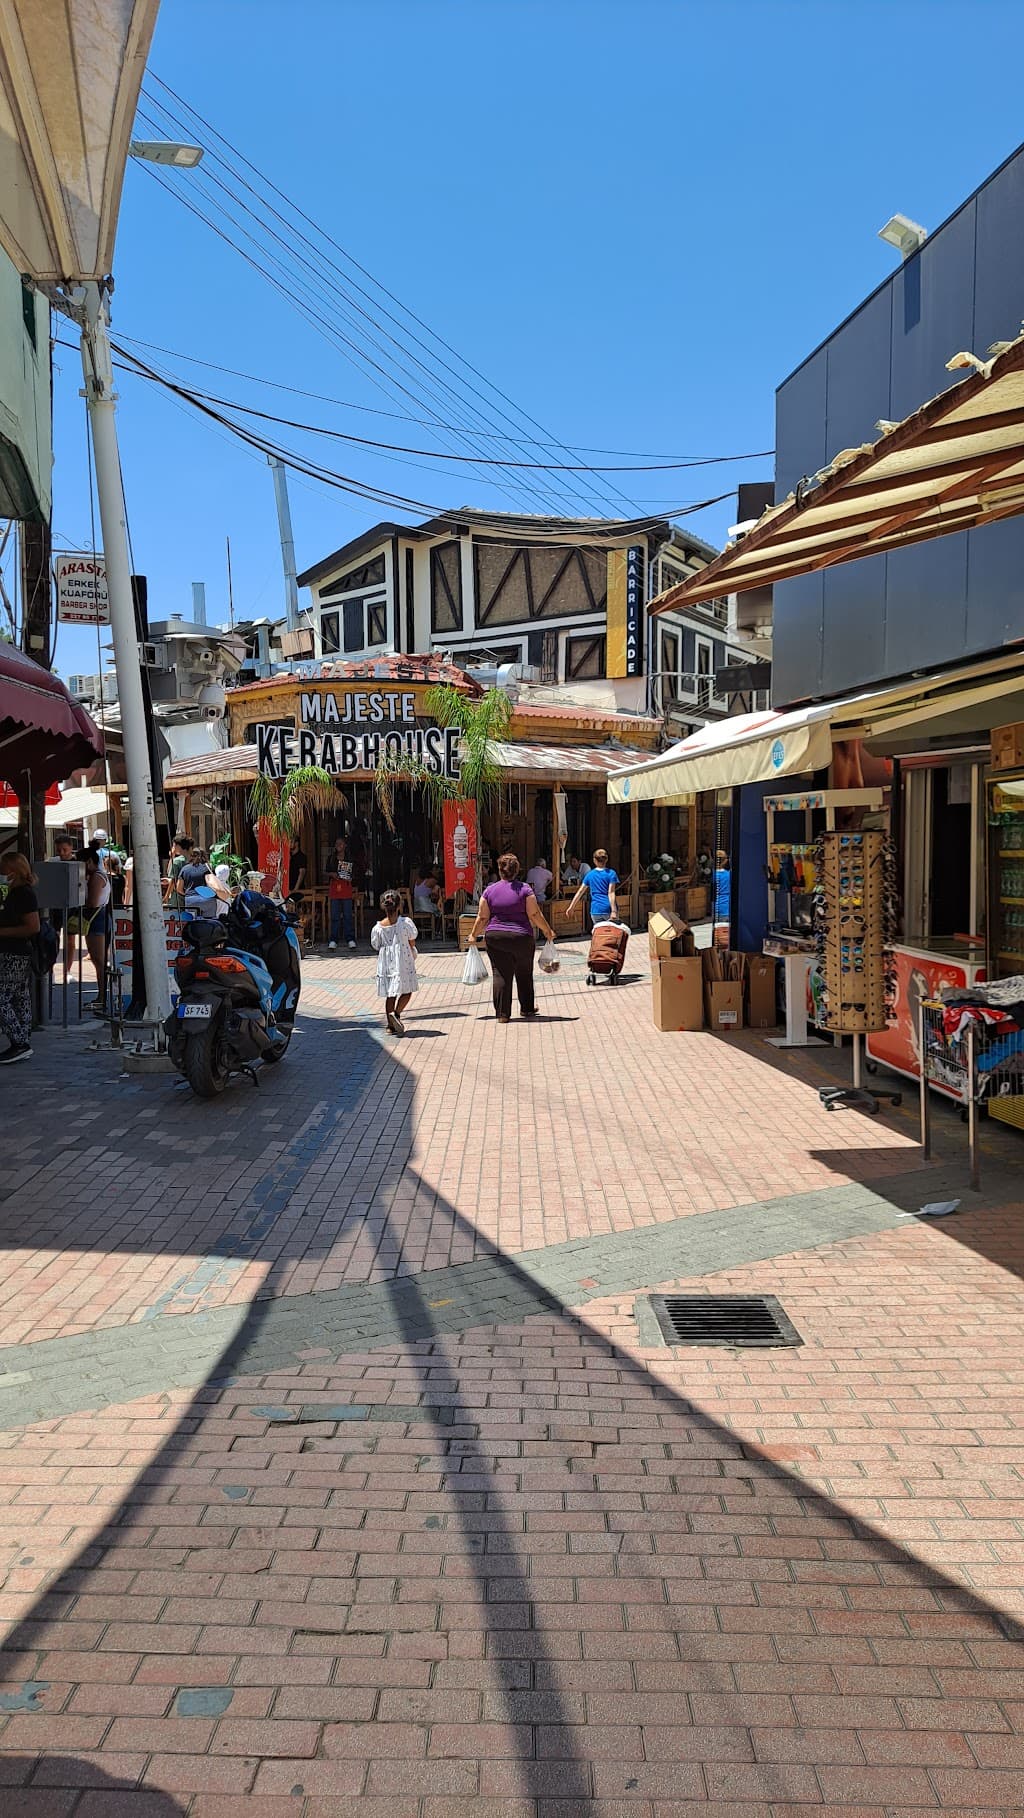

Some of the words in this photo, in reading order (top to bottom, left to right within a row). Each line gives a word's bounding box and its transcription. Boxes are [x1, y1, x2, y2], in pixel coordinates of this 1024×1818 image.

[60, 562, 107, 579] ARASTA
[68, 579, 101, 589] ERKEK
[60, 600, 88, 609] BARBER
[89, 602, 108, 611] SHOP
[627, 551, 637, 673] BARRICADE
[300, 693, 416, 723] MAJESTE
[259, 867, 288, 875] MERCN
